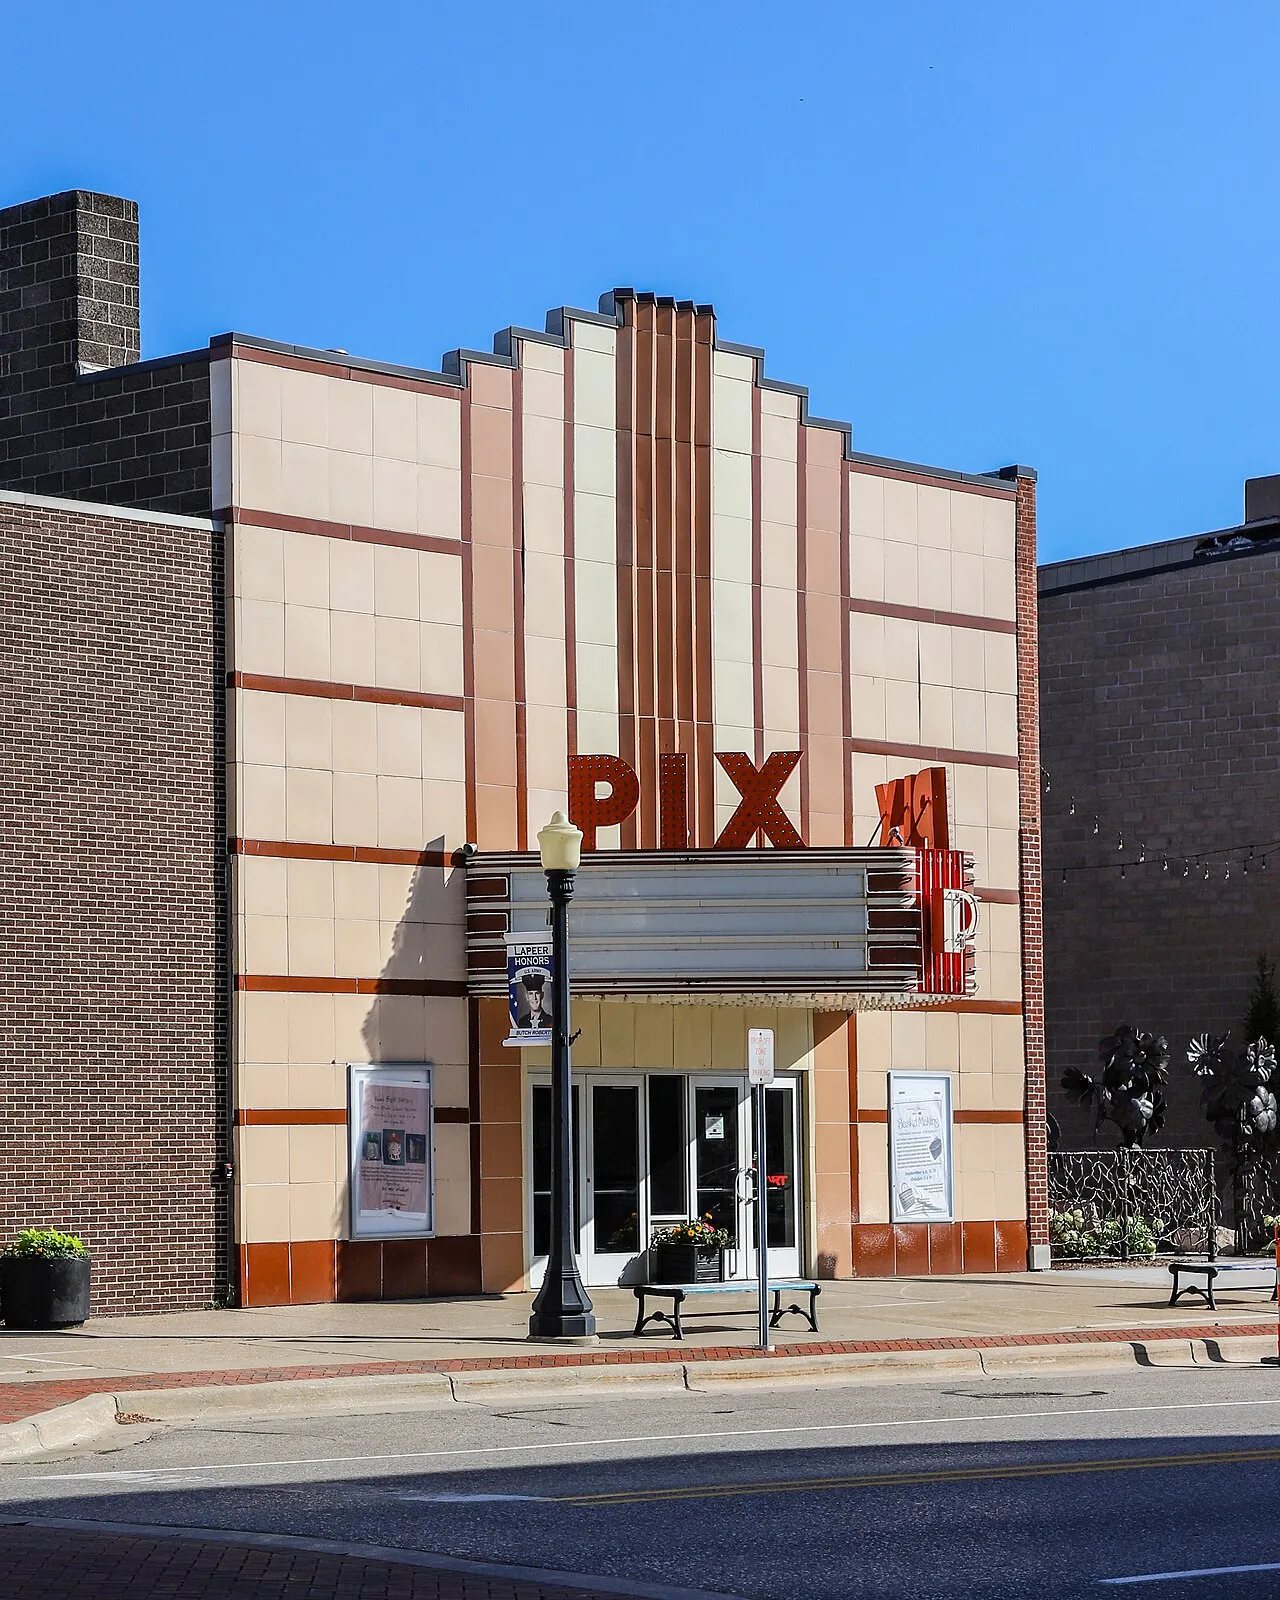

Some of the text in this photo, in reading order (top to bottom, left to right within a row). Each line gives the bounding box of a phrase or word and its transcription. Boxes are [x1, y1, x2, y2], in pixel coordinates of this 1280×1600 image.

[568, 751, 807, 849] PIX
[514, 946, 549, 955] LAPEER
[515, 957, 549, 965] HONORS
